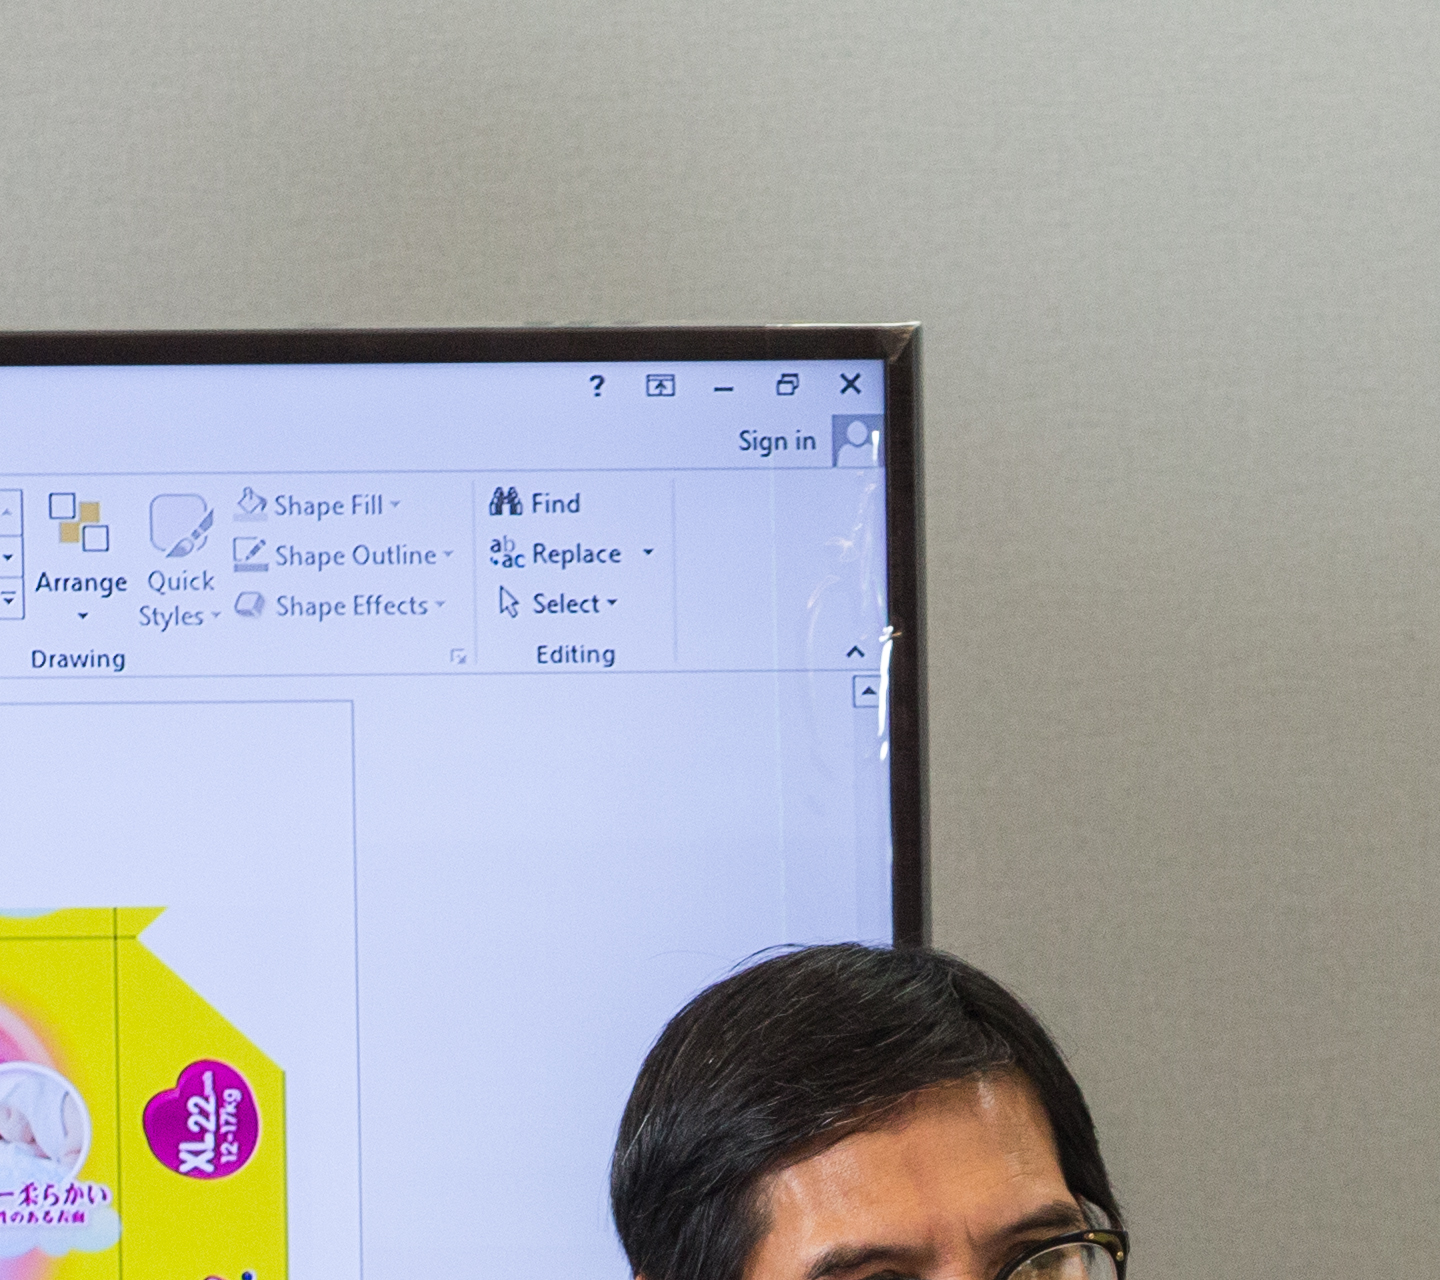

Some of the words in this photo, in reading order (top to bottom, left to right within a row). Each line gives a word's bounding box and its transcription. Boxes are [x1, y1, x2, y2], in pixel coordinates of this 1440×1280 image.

[739, 429, 787, 458] Sign
[794, 429, 817, 451] in
[274, 494, 345, 522] Shape
[351, 493, 383, 516] Fill
[531, 492, 581, 514] Find
[275, 544, 346, 573] Shape
[351, 544, 437, 566] Outline
[532, 542, 622, 570] Replace
[34, 571, 128, 599] Arrange
[147, 569, 215, 593] Quick
[276, 594, 346, 623] Shape
[353, 594, 429, 616] Effects
[533, 592, 600, 615] Select
[139, 604, 204, 633] Styles
[31, 649, 126, 673] Drawing
[536, 644, 616, 668] Editing
[220, 1088, 243, 1164] 12-17kg
